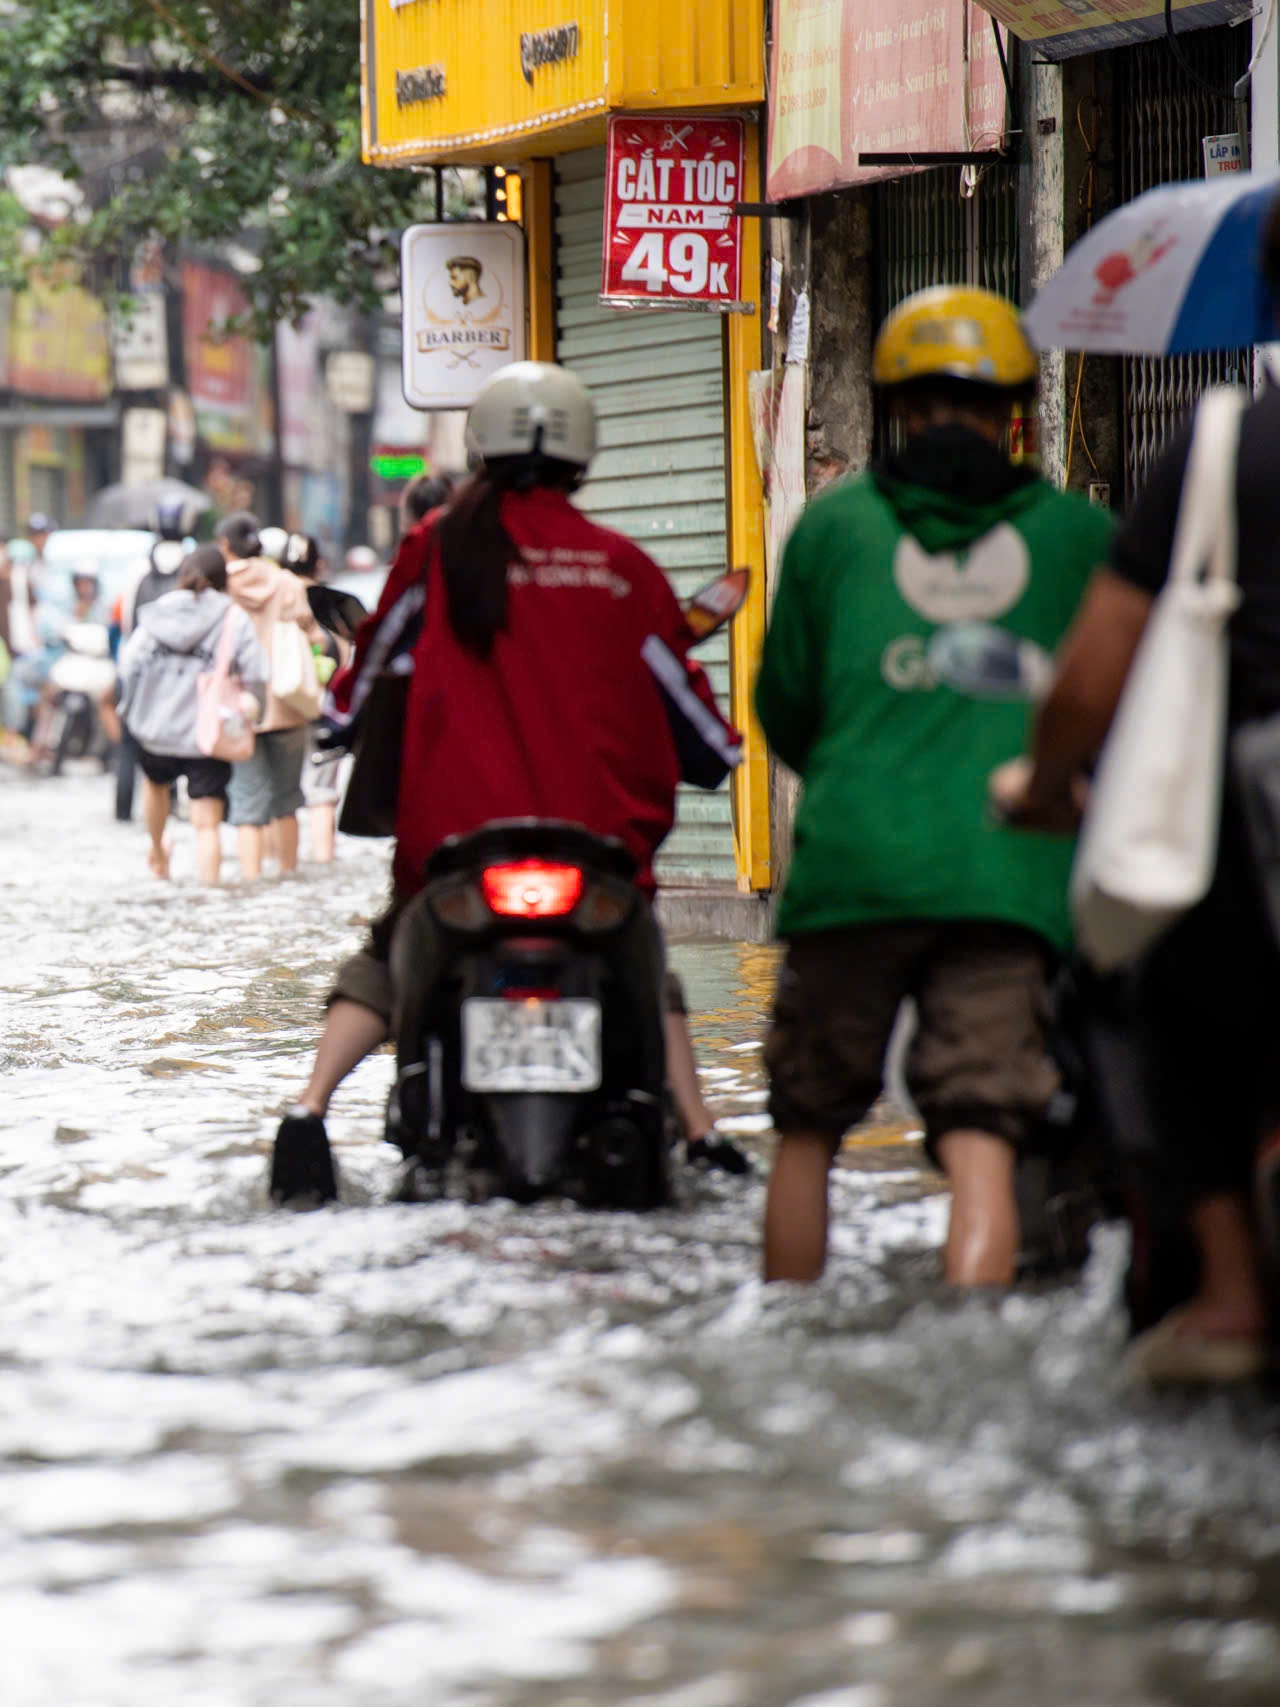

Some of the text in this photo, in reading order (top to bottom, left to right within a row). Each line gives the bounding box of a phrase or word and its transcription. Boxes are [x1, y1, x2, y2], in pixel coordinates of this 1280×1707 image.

[617, 148, 736, 203] CẮT TÓC
[647, 208, 704, 224] NAM
[621, 232, 729, 294] 49K
[425, 330, 503, 345] BARBER
